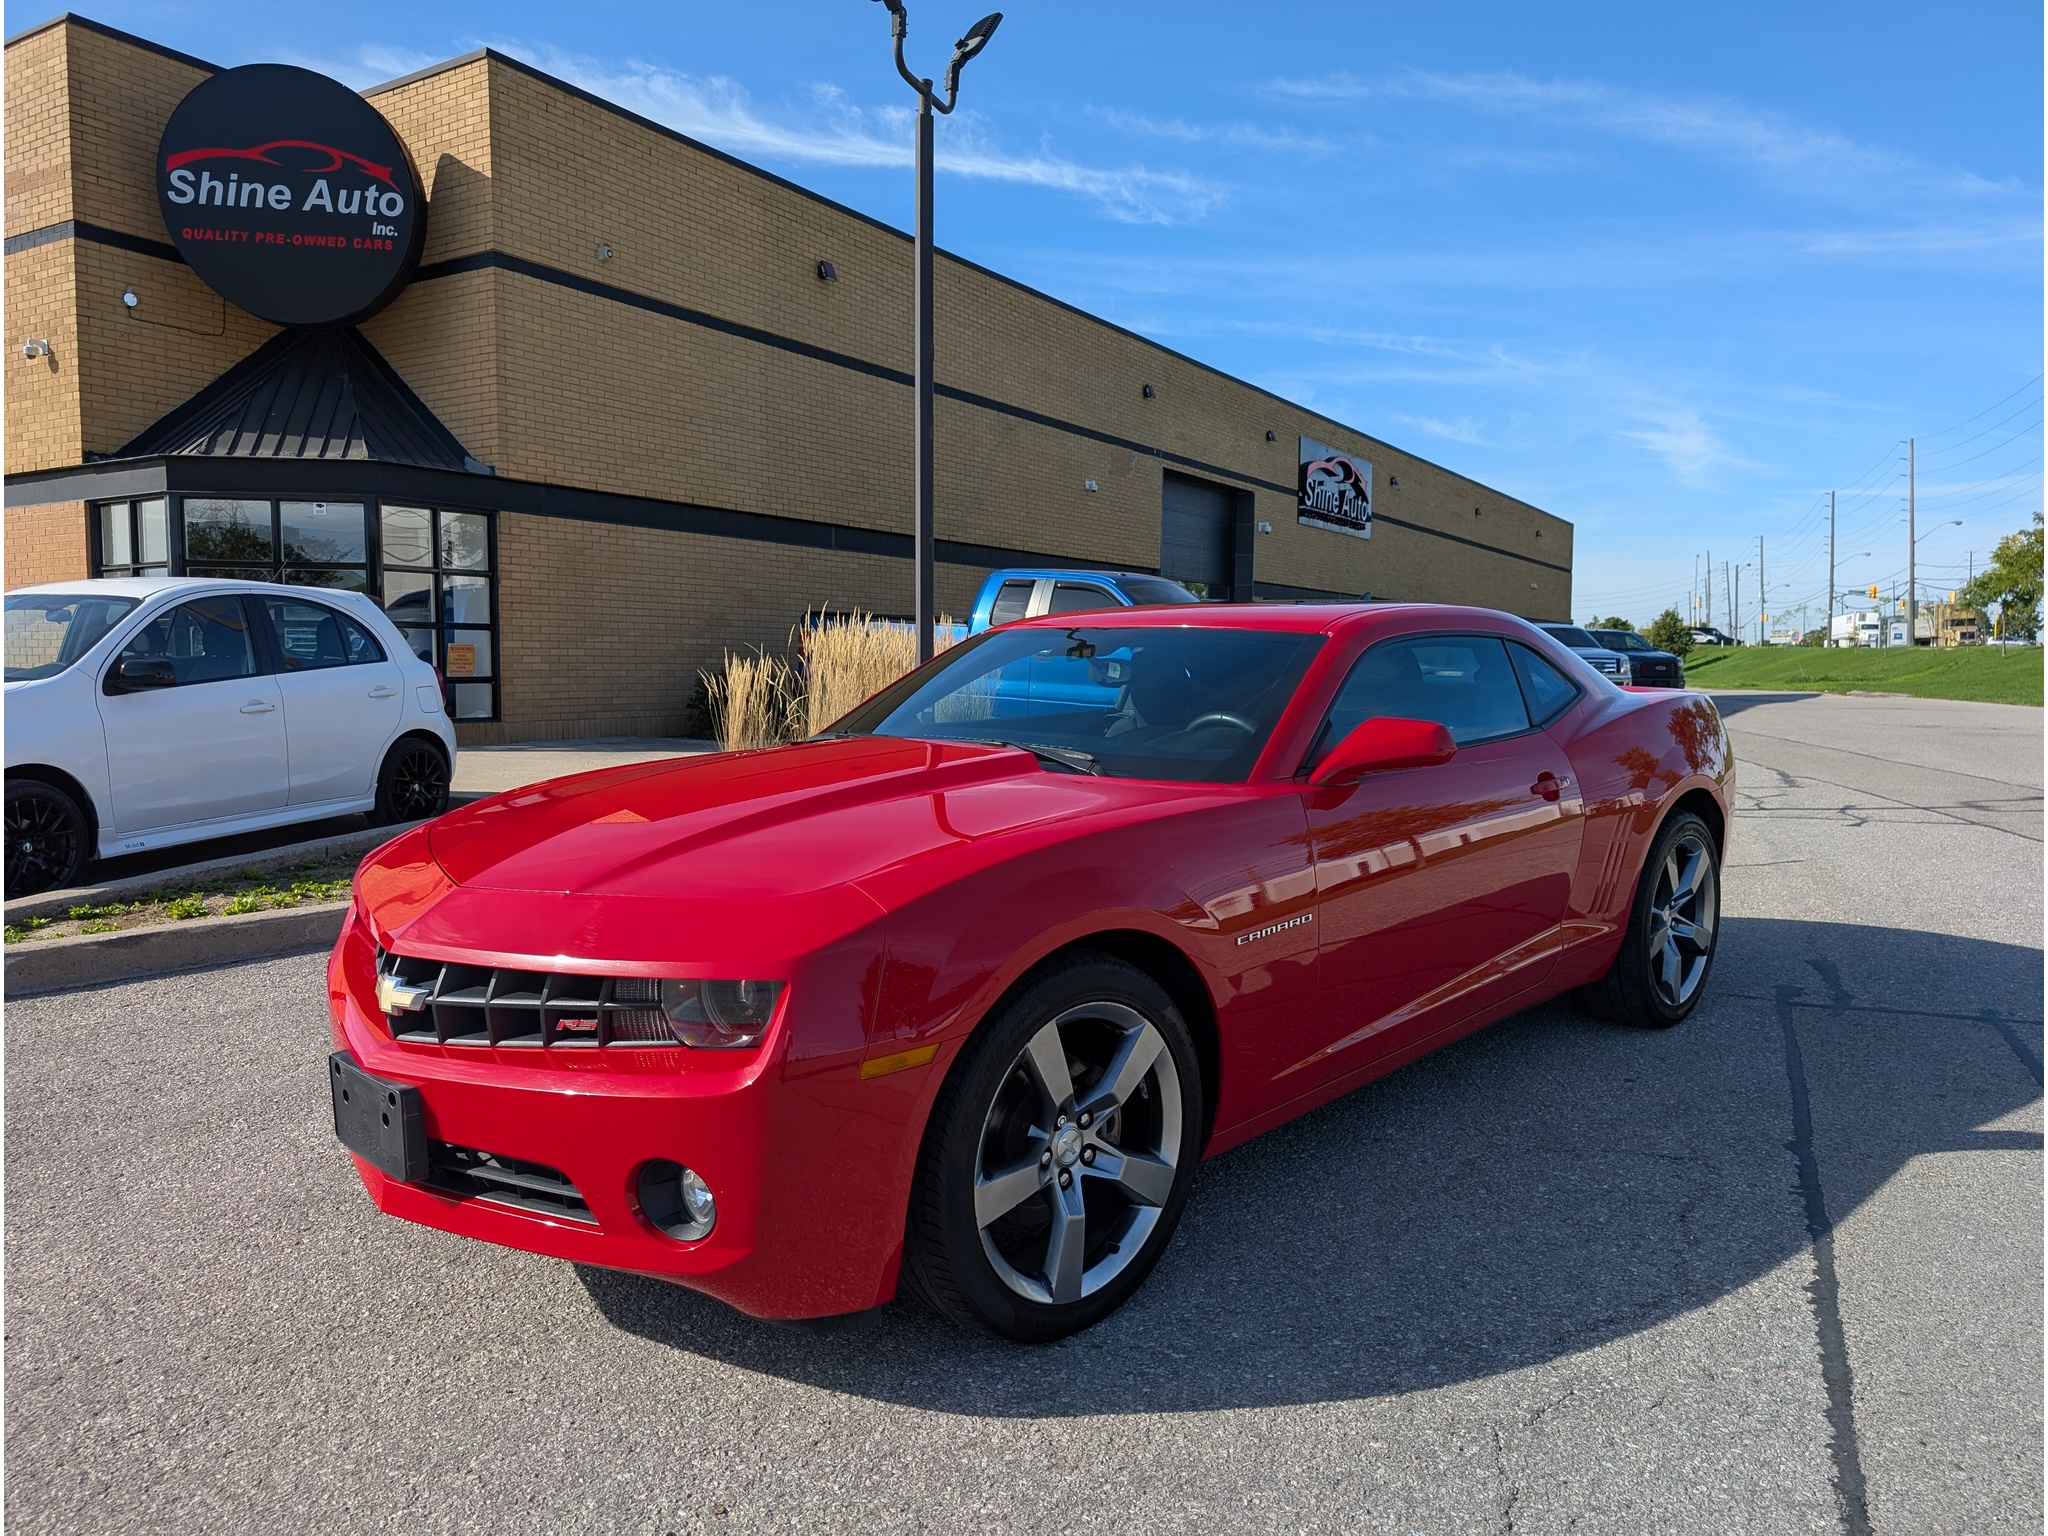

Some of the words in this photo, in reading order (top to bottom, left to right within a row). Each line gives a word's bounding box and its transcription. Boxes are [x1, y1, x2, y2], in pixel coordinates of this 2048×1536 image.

[167, 169, 292, 210] Shine
[302, 179, 405, 217] Auto
[182, 228, 249, 242] QUALITY
[255, 232, 346, 247] PRE-OWNED
[353, 237, 393, 250] CARS
[372, 222, 398, 236] Inc.
[1305, 478, 1340, 513] Shine
[1341, 490, 1369, 521] Auto
[1236, 913, 1313, 946] CAMARO
[555, 1018, 598, 1031] RS
